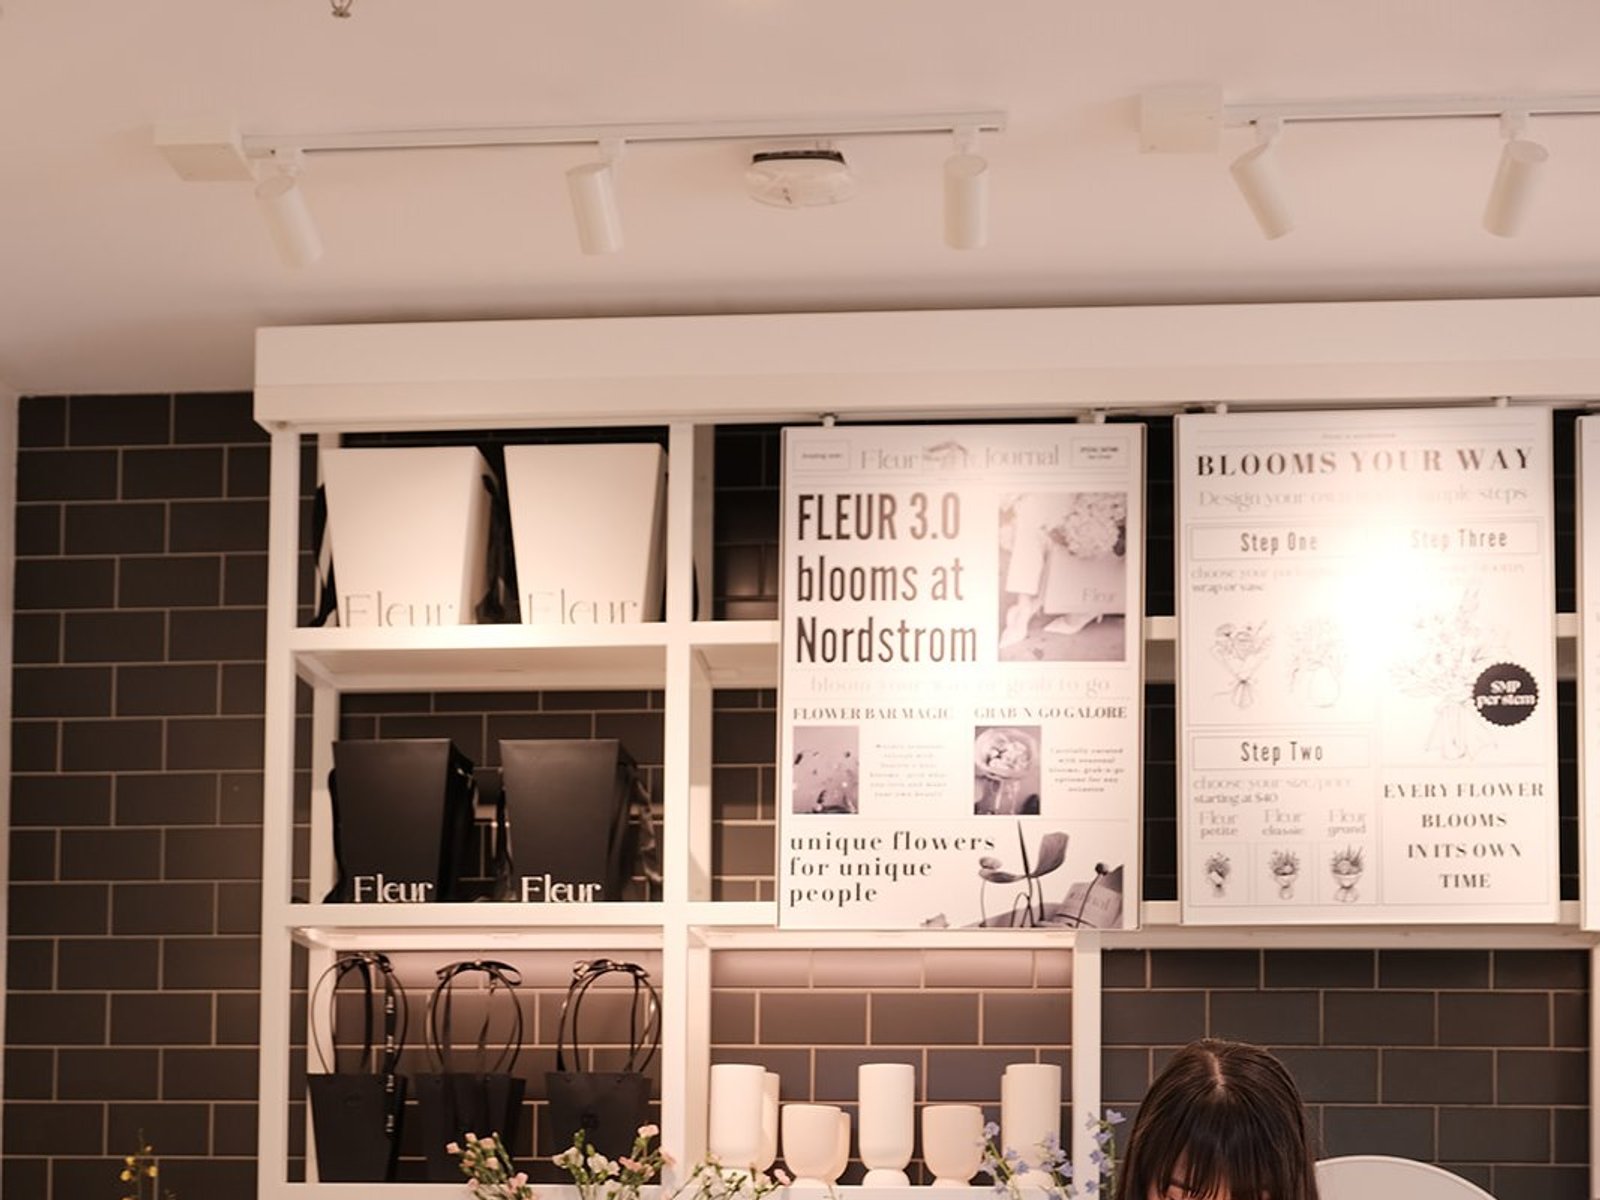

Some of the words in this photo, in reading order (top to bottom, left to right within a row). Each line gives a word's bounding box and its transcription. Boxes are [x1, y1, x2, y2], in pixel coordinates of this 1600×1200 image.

[1197, 451, 1337, 476] BLOOMS
[1350, 449, 1442, 473] YOUR
[1457, 446, 1533, 471] WAY
[797, 493, 897, 541] FLEUR
[909, 492, 961, 540] 3.0
[1240, 533, 1279, 555] Step
[1287, 530, 1318, 552] One
[1411, 530, 1449, 552] Step
[1457, 527, 1508, 548] Three
[797, 555, 918, 602] blooms
[931, 557, 965, 601] at
[345, 590, 453, 627] Fleur
[528, 588, 638, 624] Fleur
[796, 616, 977, 663] Nordstrom
[793, 707, 861, 720] FLOWER
[865, 707, 897, 720] BAR
[901, 707, 953, 720] MAGIC
[974, 707, 1017, 719] GRAB
[1039, 706, 1060, 719] GO
[1064, 706, 1127, 719] GALORE
[1240, 741, 1281, 766] Step
[1290, 741, 1323, 761] Two
[1384, 784, 1448, 798] EVERY
[1457, 783, 1544, 797] FLOWER
[1422, 814, 1507, 828] BLOOMS
[790, 832, 883, 856] unique
[893, 831, 995, 851] flowers
[1408, 844, 1427, 858] IN
[1434, 844, 1467, 858] ITS
[1472, 843, 1521, 857] OWN
[790, 857, 829, 876] for
[839, 858, 933, 882] unique
[1440, 873, 1491, 888] TIME
[353, 874, 434, 902] Fleur
[521, 874, 601, 902] Fleur
[789, 883, 878, 907] people
